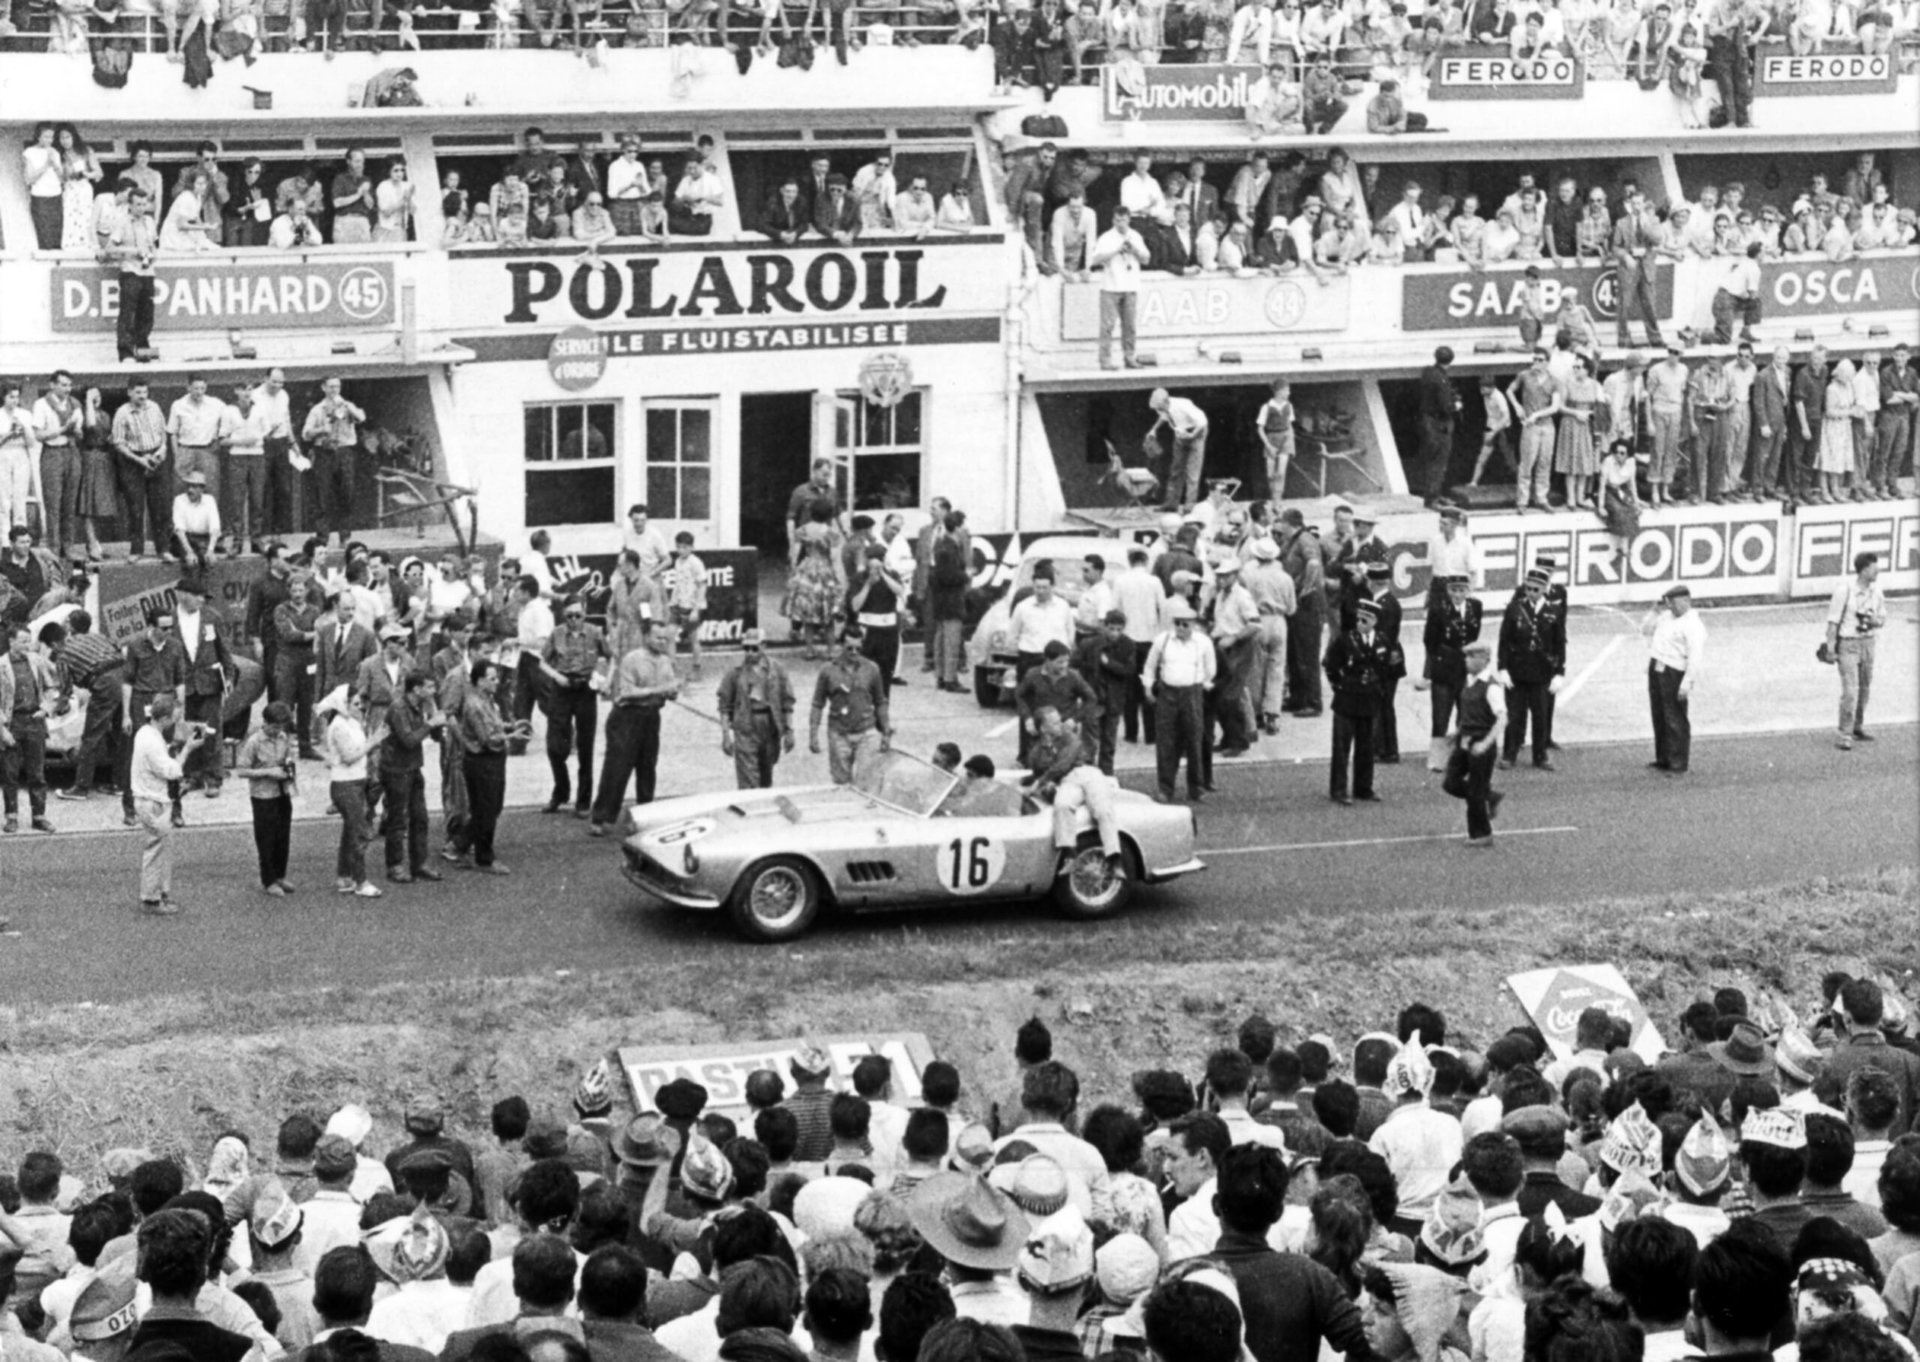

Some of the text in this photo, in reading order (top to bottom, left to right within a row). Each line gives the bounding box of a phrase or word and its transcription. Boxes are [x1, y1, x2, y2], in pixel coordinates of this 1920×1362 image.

[1446, 62, 1570, 81] FERODO
[1769, 57, 1885, 78] FERODO
[152, 275, 332, 317] PANHARD
[343, 278, 380, 307] 45
[504, 250, 947, 323] POLAROIL
[1448, 278, 1561, 318] SAAB
[1774, 268, 1879, 306] OSCA
[1141, 288, 1231, 326] AAB
[1474, 522, 1775, 590] FERODO
[949, 837, 991, 889] 16
